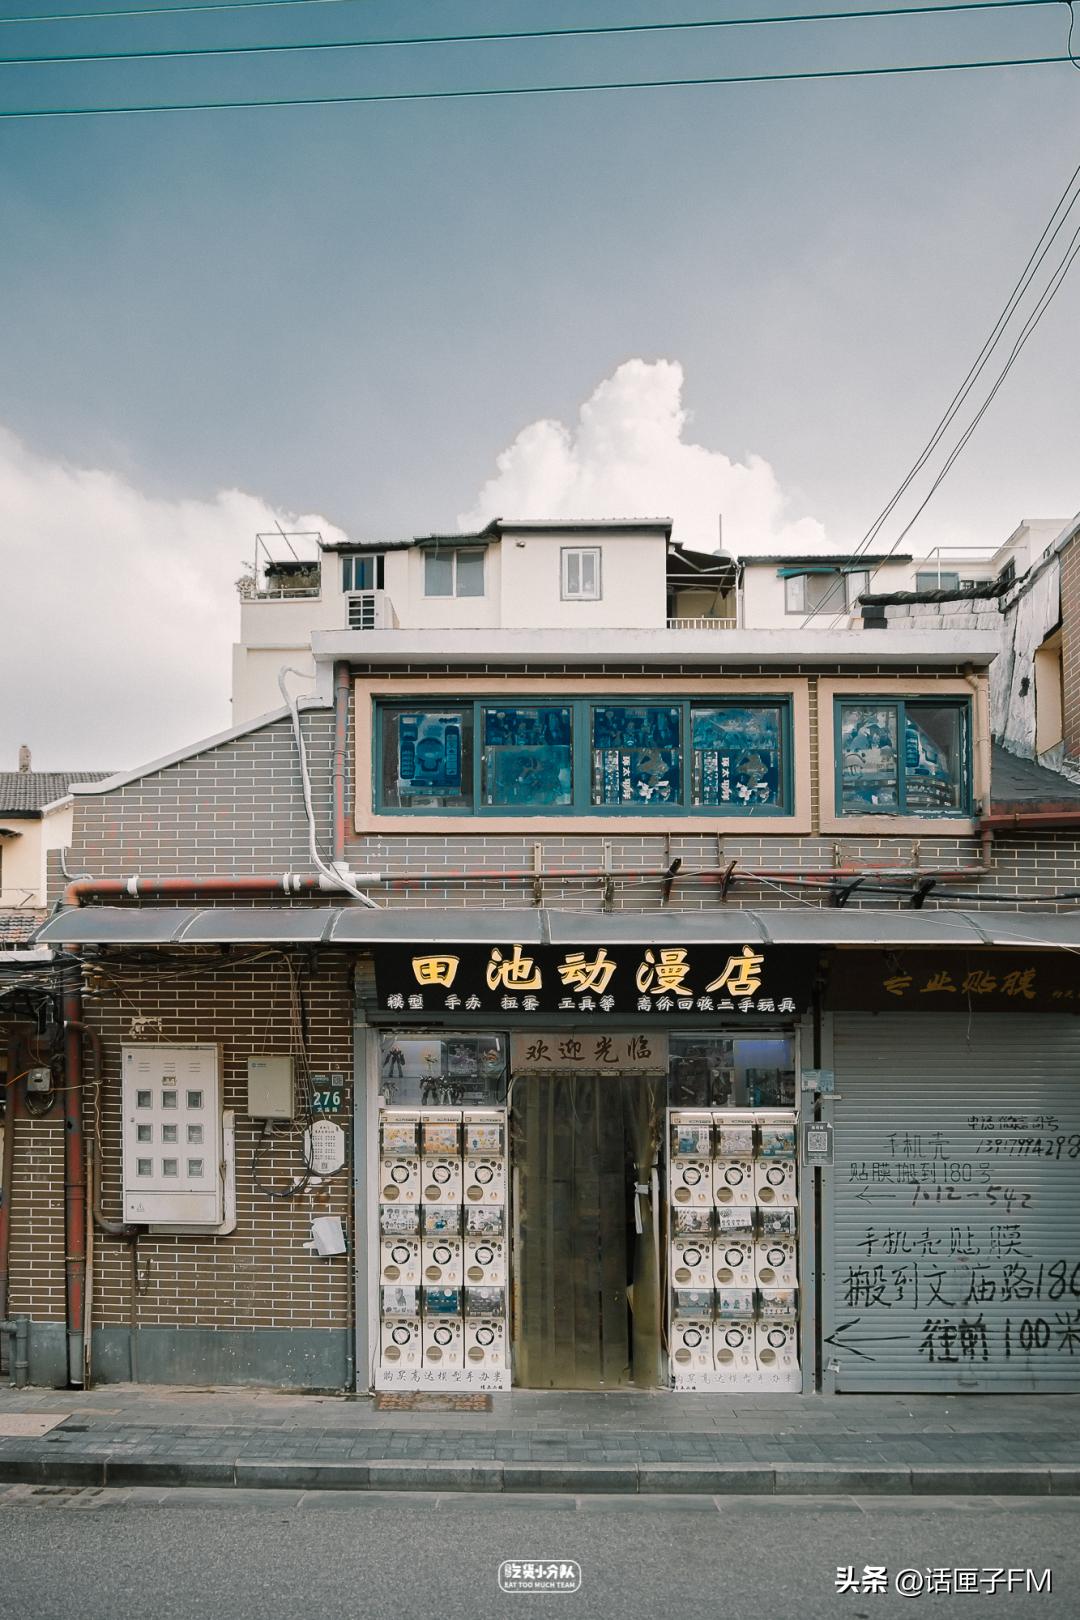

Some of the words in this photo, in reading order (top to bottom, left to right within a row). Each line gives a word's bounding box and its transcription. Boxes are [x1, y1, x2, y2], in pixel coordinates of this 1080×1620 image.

[411, 944, 765, 996] 田池动漫店
[883, 966, 1037, 999] 专业贴膜
[387, 993, 424, 1010] 模型
[445, 994, 481, 1010] 手办
[501, 995, 540, 1011] 扭蛋
[558, 995, 615, 1012] 工具等
[637, 996, 797, 1013] 高价回收二手玩具
[525, 1034, 653, 1064] 欢迎光临
[313, 1091, 341, 1106] 276
[857, 1224, 1033, 1259] 手机壳贴膜
